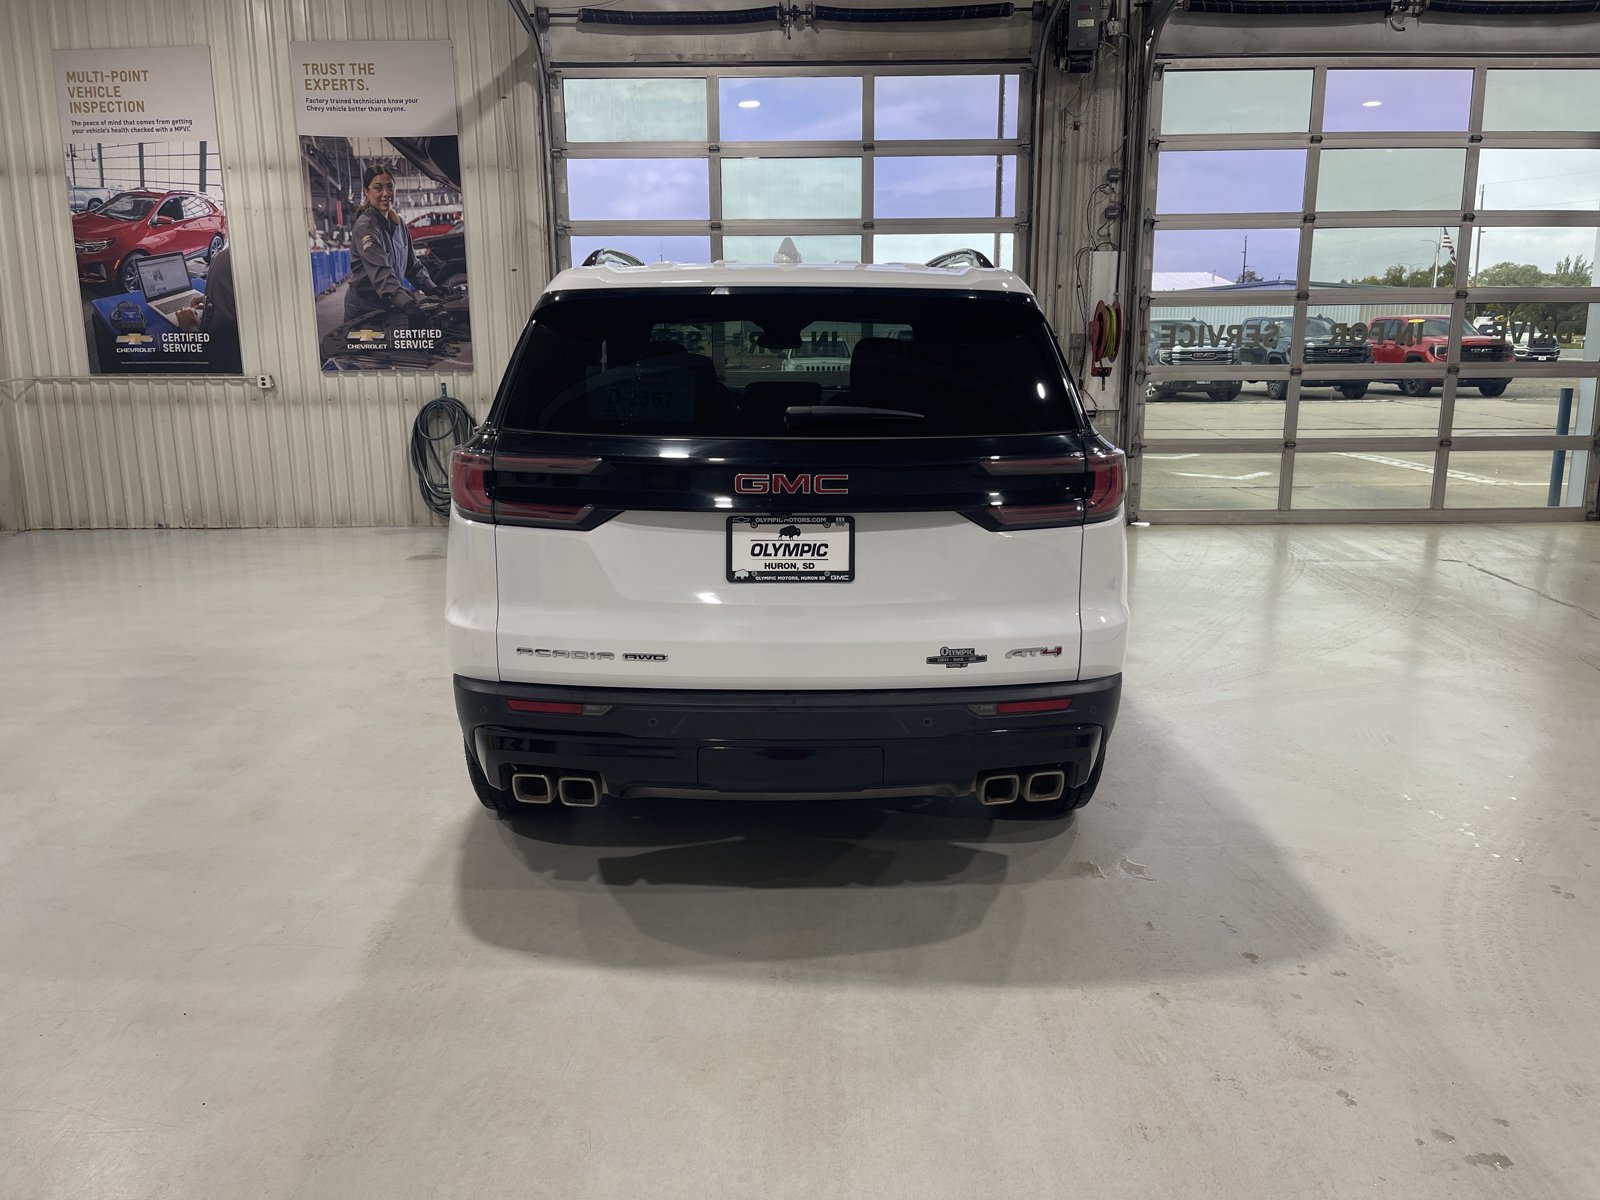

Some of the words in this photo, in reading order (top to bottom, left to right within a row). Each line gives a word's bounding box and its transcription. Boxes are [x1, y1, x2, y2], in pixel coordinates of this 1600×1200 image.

[302, 63, 345, 76] TRUST
[349, 63, 376, 75] THE
[66, 70, 149, 83] MULTI-POINT
[304, 78, 369, 91] EXPERTS.
[67, 86, 121, 98] VEHICLE
[69, 100, 145, 114] INSPECTION
[305, 97, 329, 105] Factory
[171, 118, 193, 126] getting
[161, 333, 210, 342] CERTIFIED
[394, 329, 442, 338] CERTIFIED
[162, 343, 203, 353] SERVICE
[394, 339, 435, 349] SERVICE
[735, 473, 849, 495] GMC
[750, 543, 829, 557] OLYMPIC
[764, 562, 800, 571] HURON,
[802, 562, 815, 570] SD
[516, 647, 615, 660] ACADIA
[622, 652, 669, 662] AWD
[940, 647, 976, 656] OLYMPIC
[1005, 646, 1063, 659] AT4
